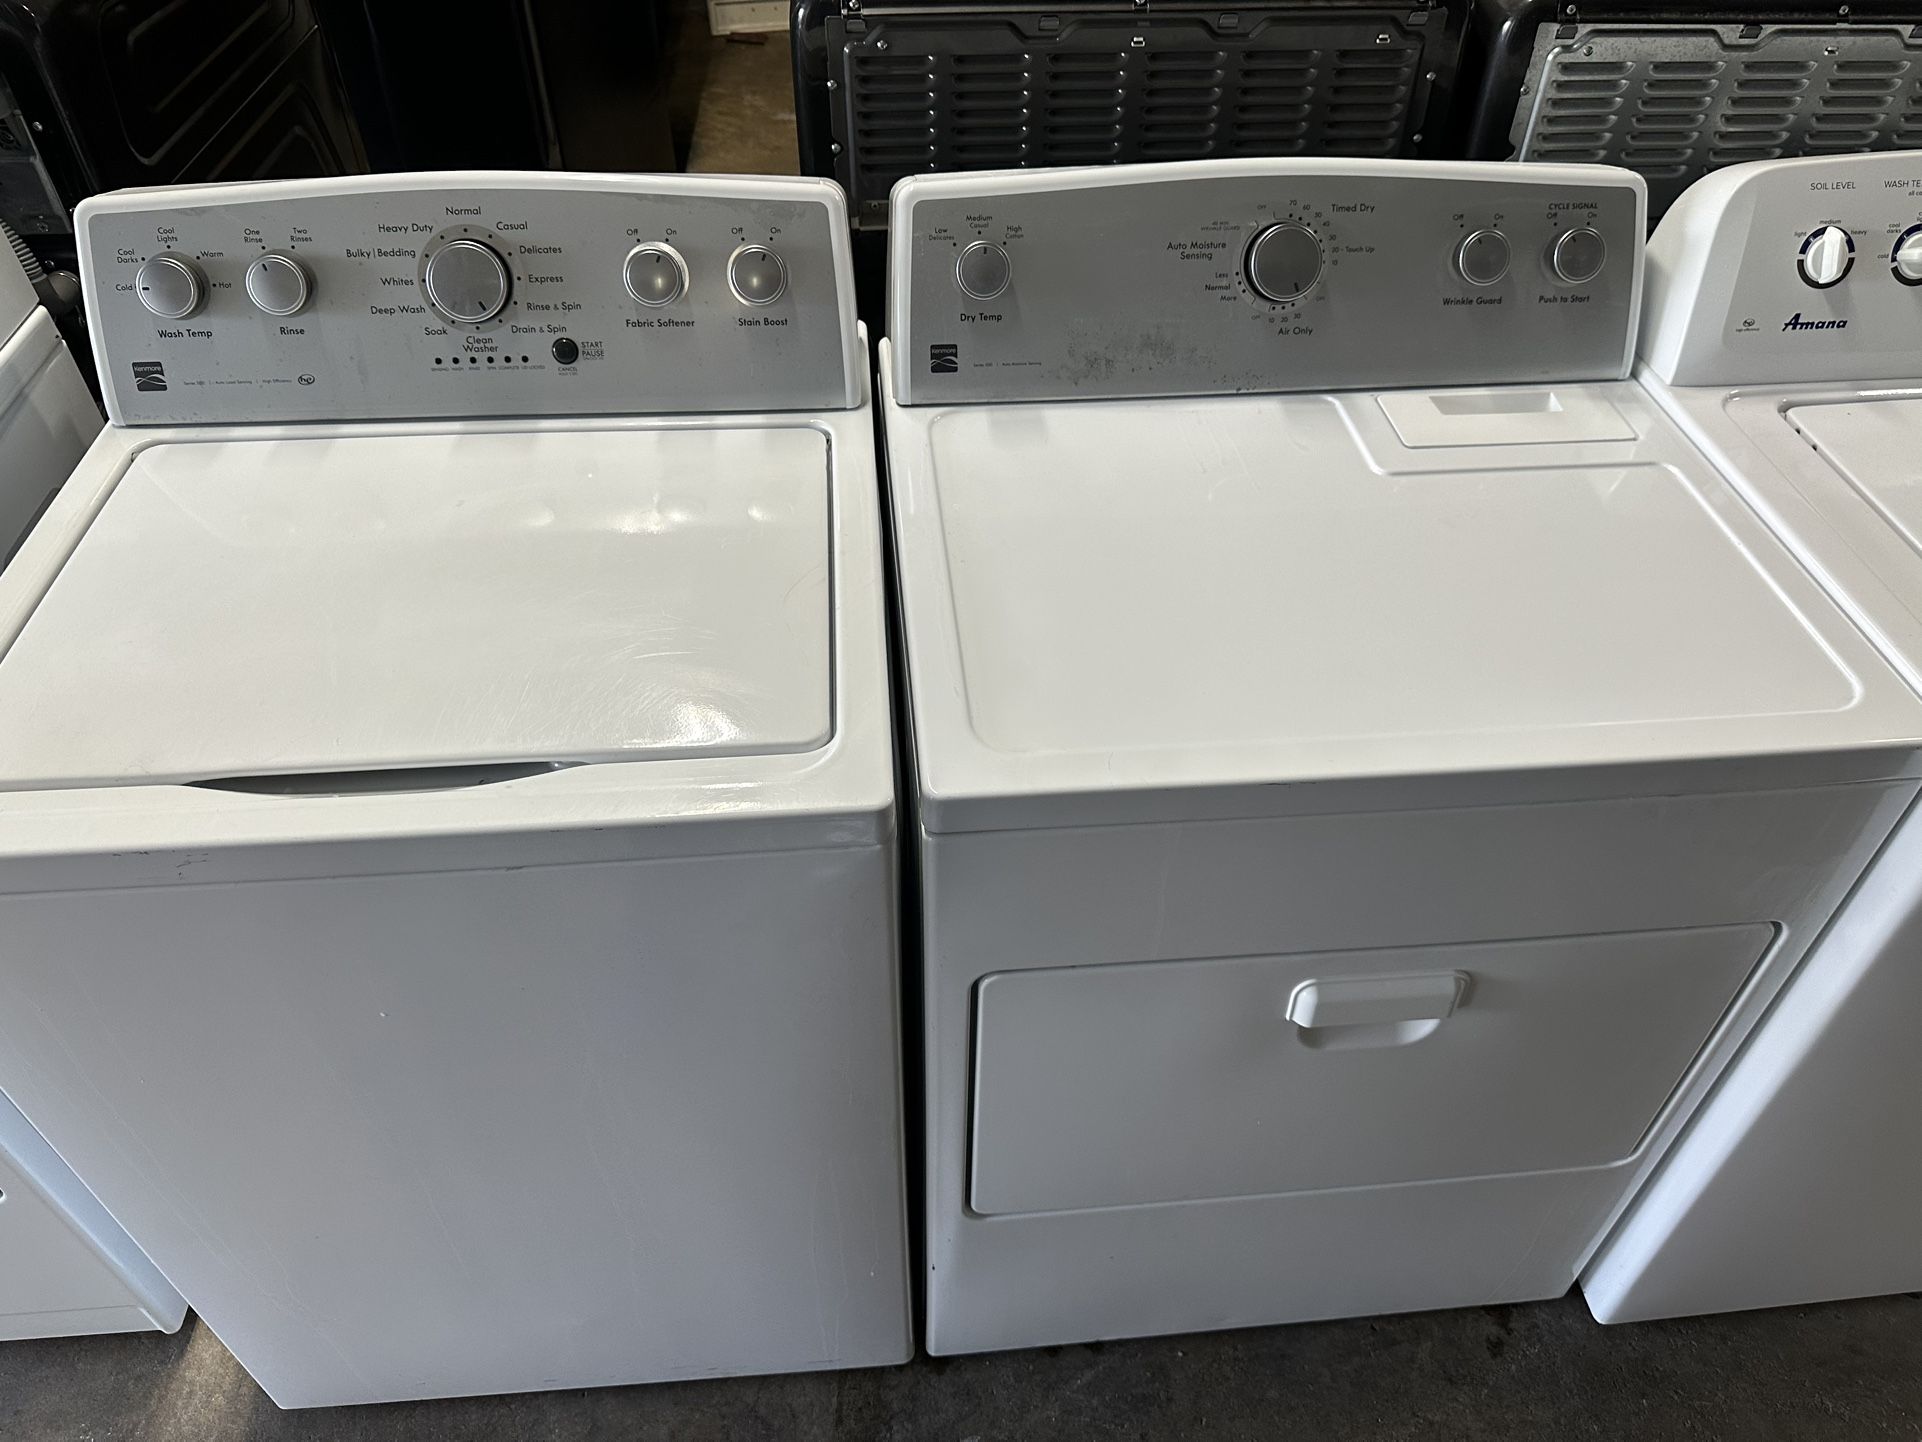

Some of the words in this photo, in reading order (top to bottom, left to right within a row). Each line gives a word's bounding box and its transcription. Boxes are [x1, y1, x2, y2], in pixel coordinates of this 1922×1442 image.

[446, 207, 481, 216] Normal
[1332, 204, 1356, 212] Timed
[1360, 204, 1375, 213] Dry
[378, 224, 408, 233] Heavy
[412, 224, 433, 233] Duty
[496, 222, 528, 230] Casual
[157, 235, 178, 244] Lights
[520, 246, 562, 254] Delicates
[1167, 242, 1188, 250] Auto
[1190, 241, 1226, 249] Moisture
[346, 249, 371, 259] Bulky
[377, 249, 416, 258] Bedding
[1180, 252, 1212, 261] Sensing
[380, 278, 414, 286] Whites
[528, 275, 563, 285] Express
[1443, 298, 1473, 306] Wrinkle
[371, 306, 395, 316] Deep
[398, 305, 425, 313] Wash
[527, 302, 550, 311] Rinse
[561, 302, 581, 312] Spin
[738, 318, 761, 326] Stain
[764, 317, 788, 326] Boost
[960, 313, 976, 322] Dry
[979, 313, 1002, 322] Temp
[657, 319, 695, 327] Softener
[1782, 313, 1848, 332] Amana
[158, 330, 183, 338] Wash
[186, 329, 213, 339] Temp
[280, 327, 305, 335] Rinse
[424, 327, 448, 335] Soak
[511, 325, 536, 334] Drain
[547, 325, 567, 334] Spin
[1278, 327, 1290, 335] Air
[1293, 327, 1313, 336] Only
[466, 336, 493, 344] Clean
